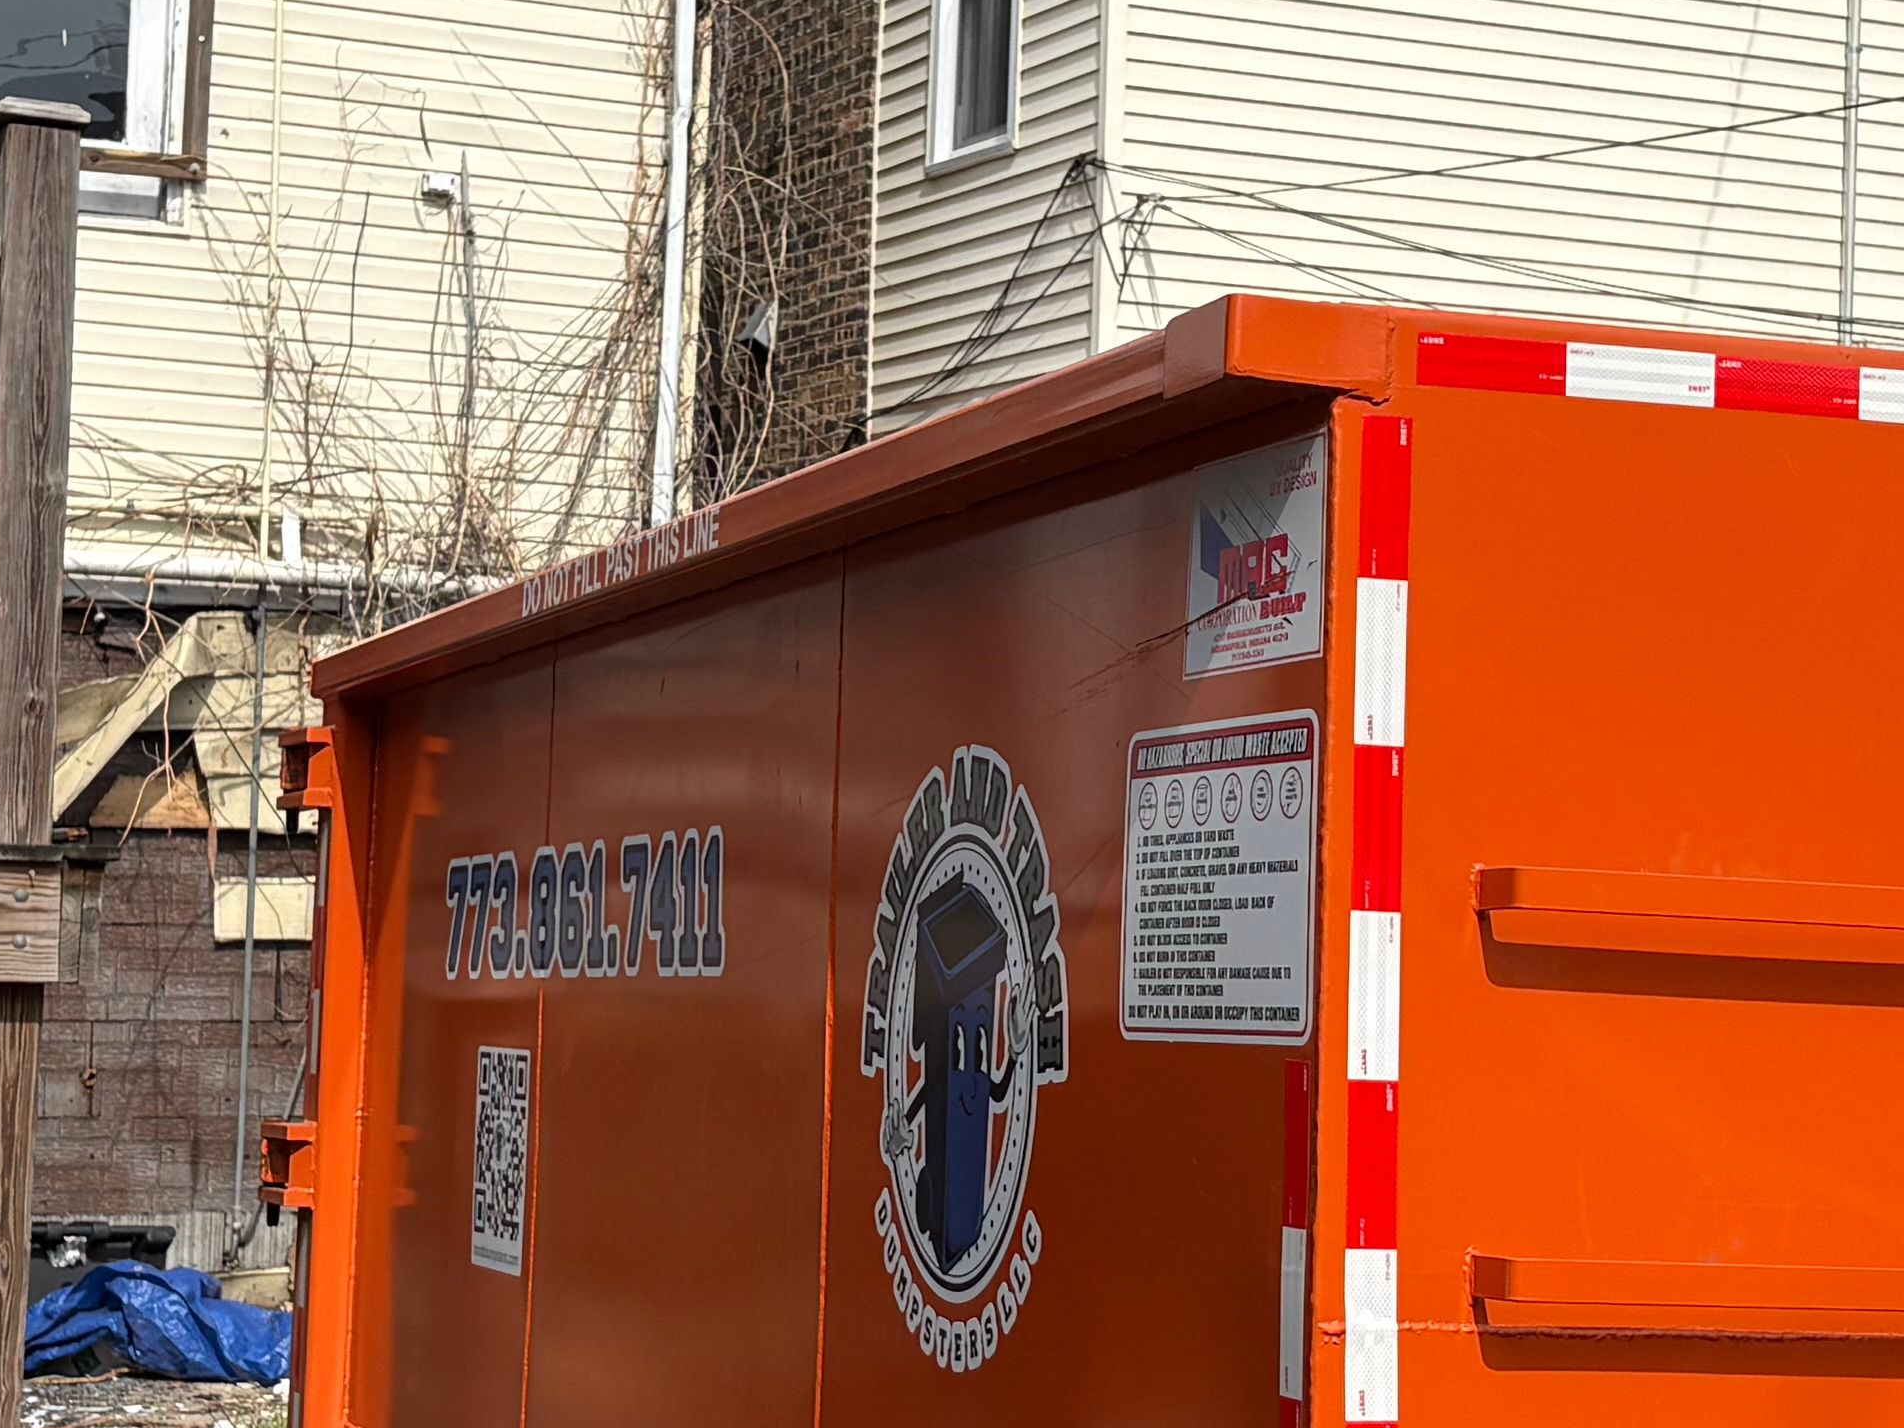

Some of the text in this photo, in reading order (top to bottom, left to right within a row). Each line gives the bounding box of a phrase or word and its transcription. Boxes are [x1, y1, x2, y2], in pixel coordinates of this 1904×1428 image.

[1269, 470, 1317, 496] BY DESIGN
[1276, 452, 1312, 476] QUALITY
[522, 507, 721, 618] DO NOT FILL PAST THIS LINE
[1217, 533, 1288, 603] MAC
[1260, 592, 1306, 620] BUILT
[950, 751, 1007, 837] AND
[447, 830, 724, 977] 773.861.7411
[865, 769, 944, 1073] TRAILER
[1007, 787, 1066, 1078] TRASH
[877, 1190, 1041, 1370] DUMPSTERS LLC
